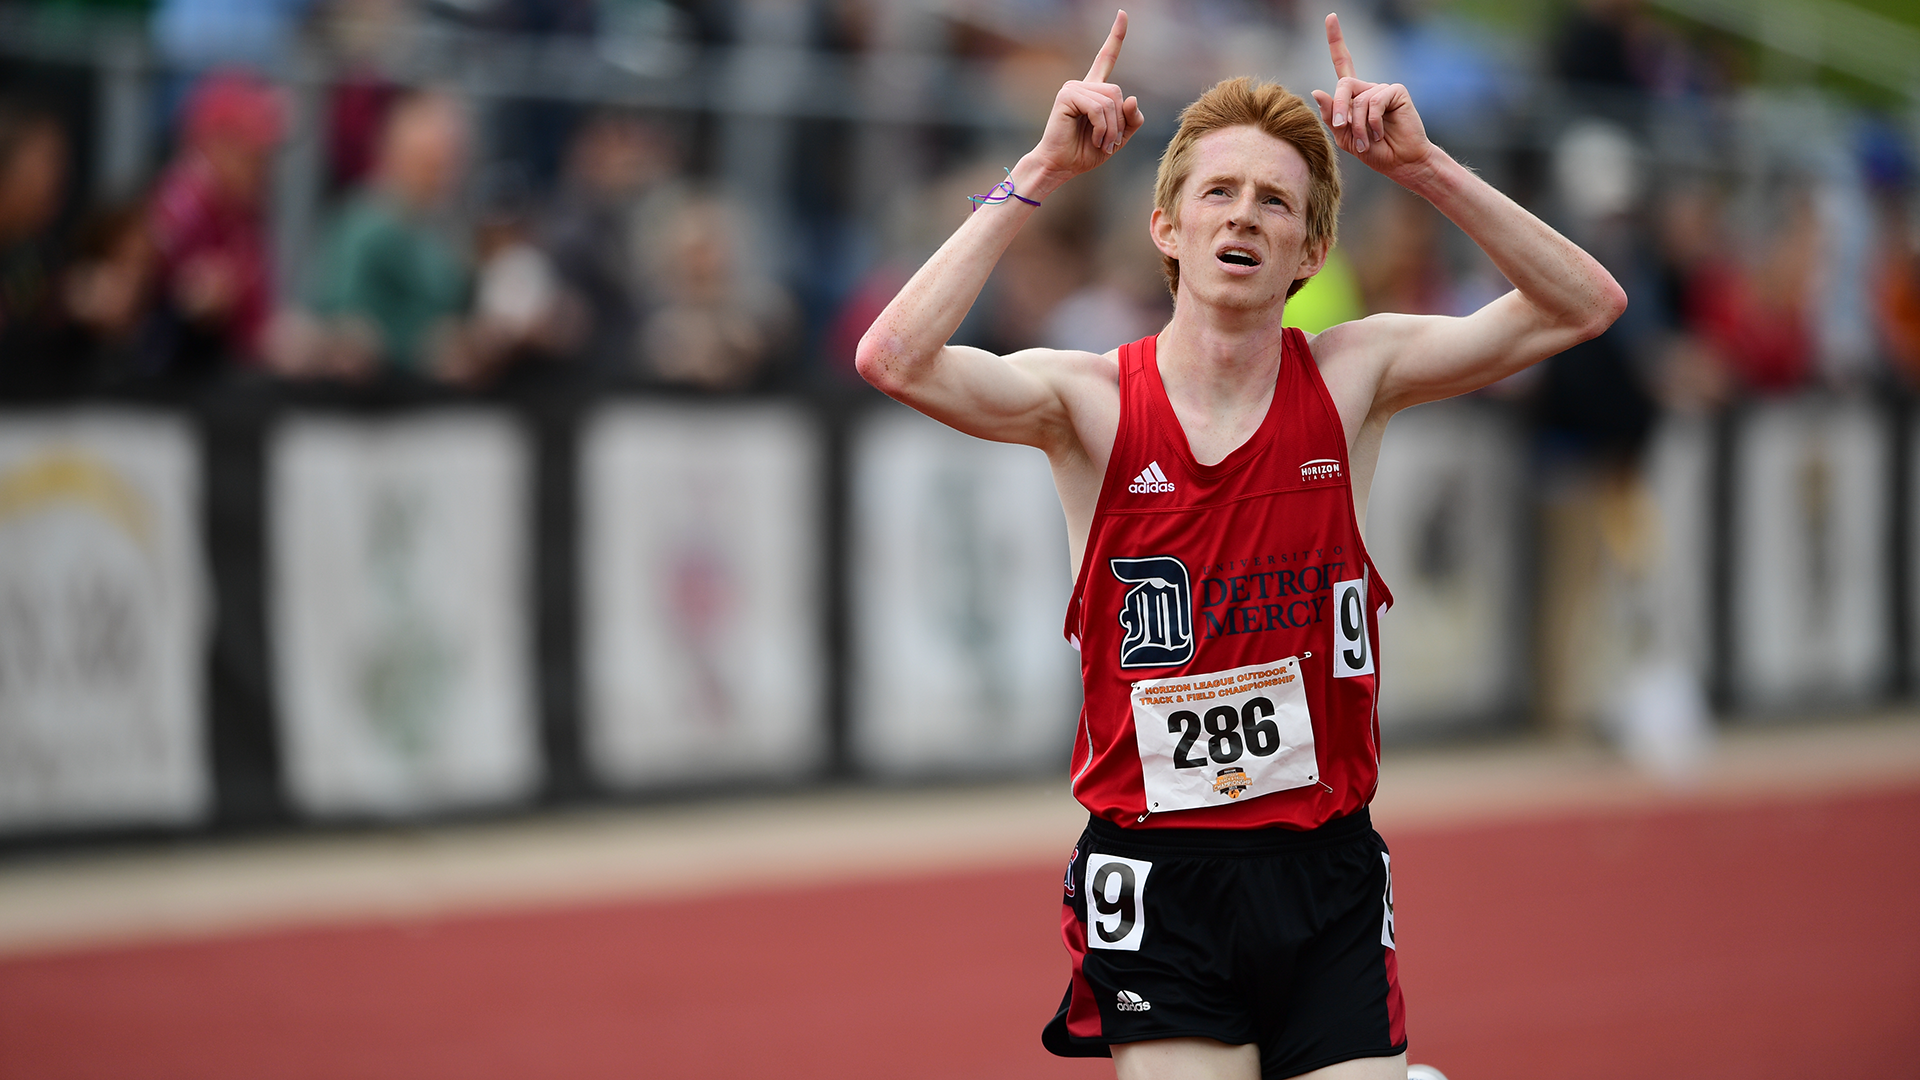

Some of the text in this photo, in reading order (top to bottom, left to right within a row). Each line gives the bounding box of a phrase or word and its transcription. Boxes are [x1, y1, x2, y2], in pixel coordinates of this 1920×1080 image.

[1128, 481, 1175, 493] adidas
[1301, 463, 1340, 476] HORIZON
[1203, 548, 1323, 576] UNIVERSITY
[1200, 562, 1345, 608] DETROIT
[1201, 596, 1328, 640] MERCY
[1341, 586, 1367, 670] 9
[1139, 674, 1296, 706] TRACK & FIELD CHAMPIONSHIP
[1144, 666, 1288, 695] HORIZON LEAGUE OUTDOOR
[1167, 696, 1280, 770] 286
[1092, 861, 1136, 943] 9
